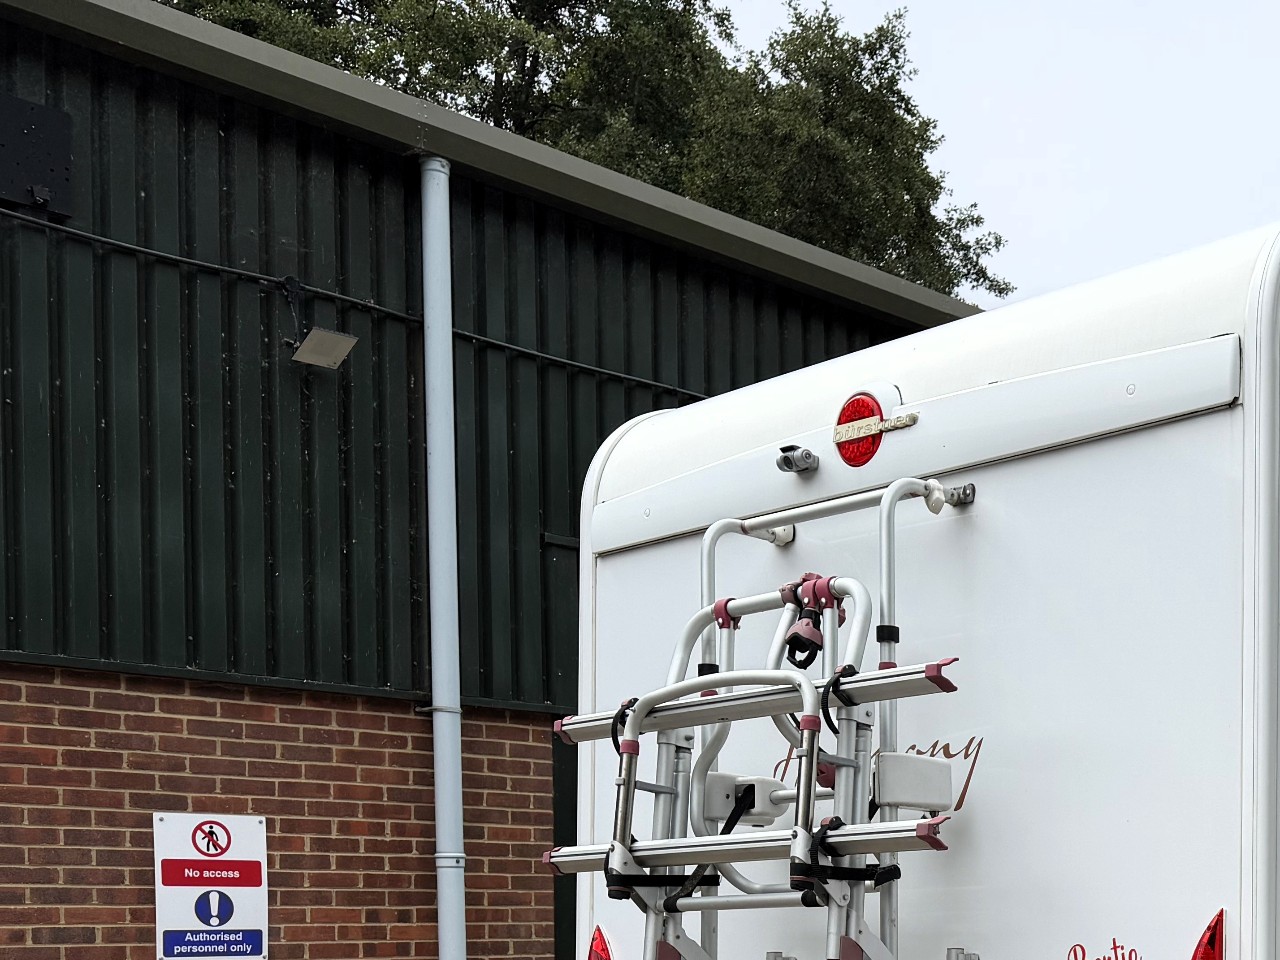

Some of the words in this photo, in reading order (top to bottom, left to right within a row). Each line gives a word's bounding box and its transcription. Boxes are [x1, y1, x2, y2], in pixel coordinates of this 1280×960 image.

[184, 868, 200, 878] No
[203, 869, 240, 878] access
[184, 931, 243, 942] Authorised
[174, 943, 227, 955] personnel
[230, 942, 252, 954] only
